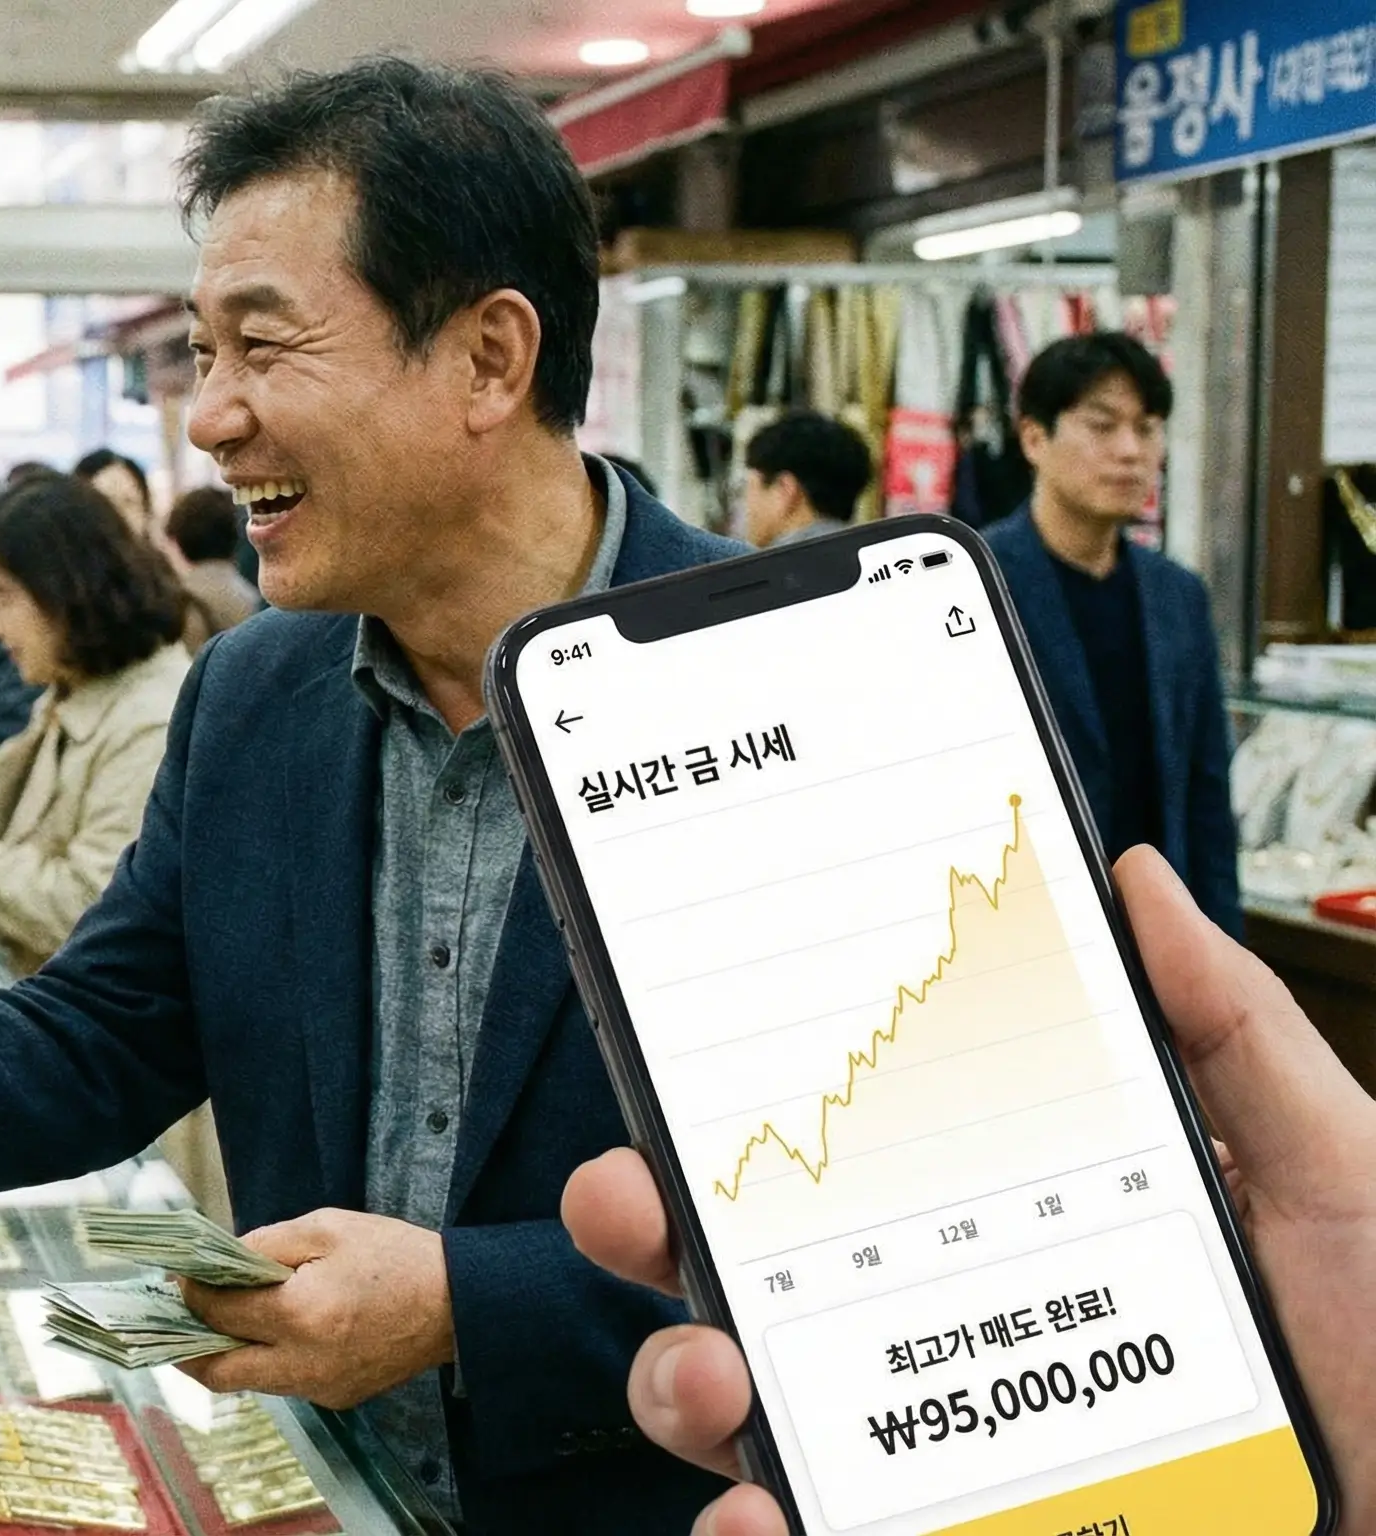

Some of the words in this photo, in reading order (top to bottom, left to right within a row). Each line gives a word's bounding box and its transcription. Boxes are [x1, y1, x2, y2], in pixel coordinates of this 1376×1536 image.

[551, 642, 591, 665] 9:41
[579, 755, 678, 813] 실시간
[685, 746, 719, 785] 금
[730, 724, 796, 770] 시세
[764, 1270, 795, 1293] 7월
[886, 1324, 975, 1374] 최고가
[979, 1308, 1043, 1347] 매도
[1042, 1287, 1116, 1334] 완료!
[868, 1334, 1174, 1455] ₩95,000,000
